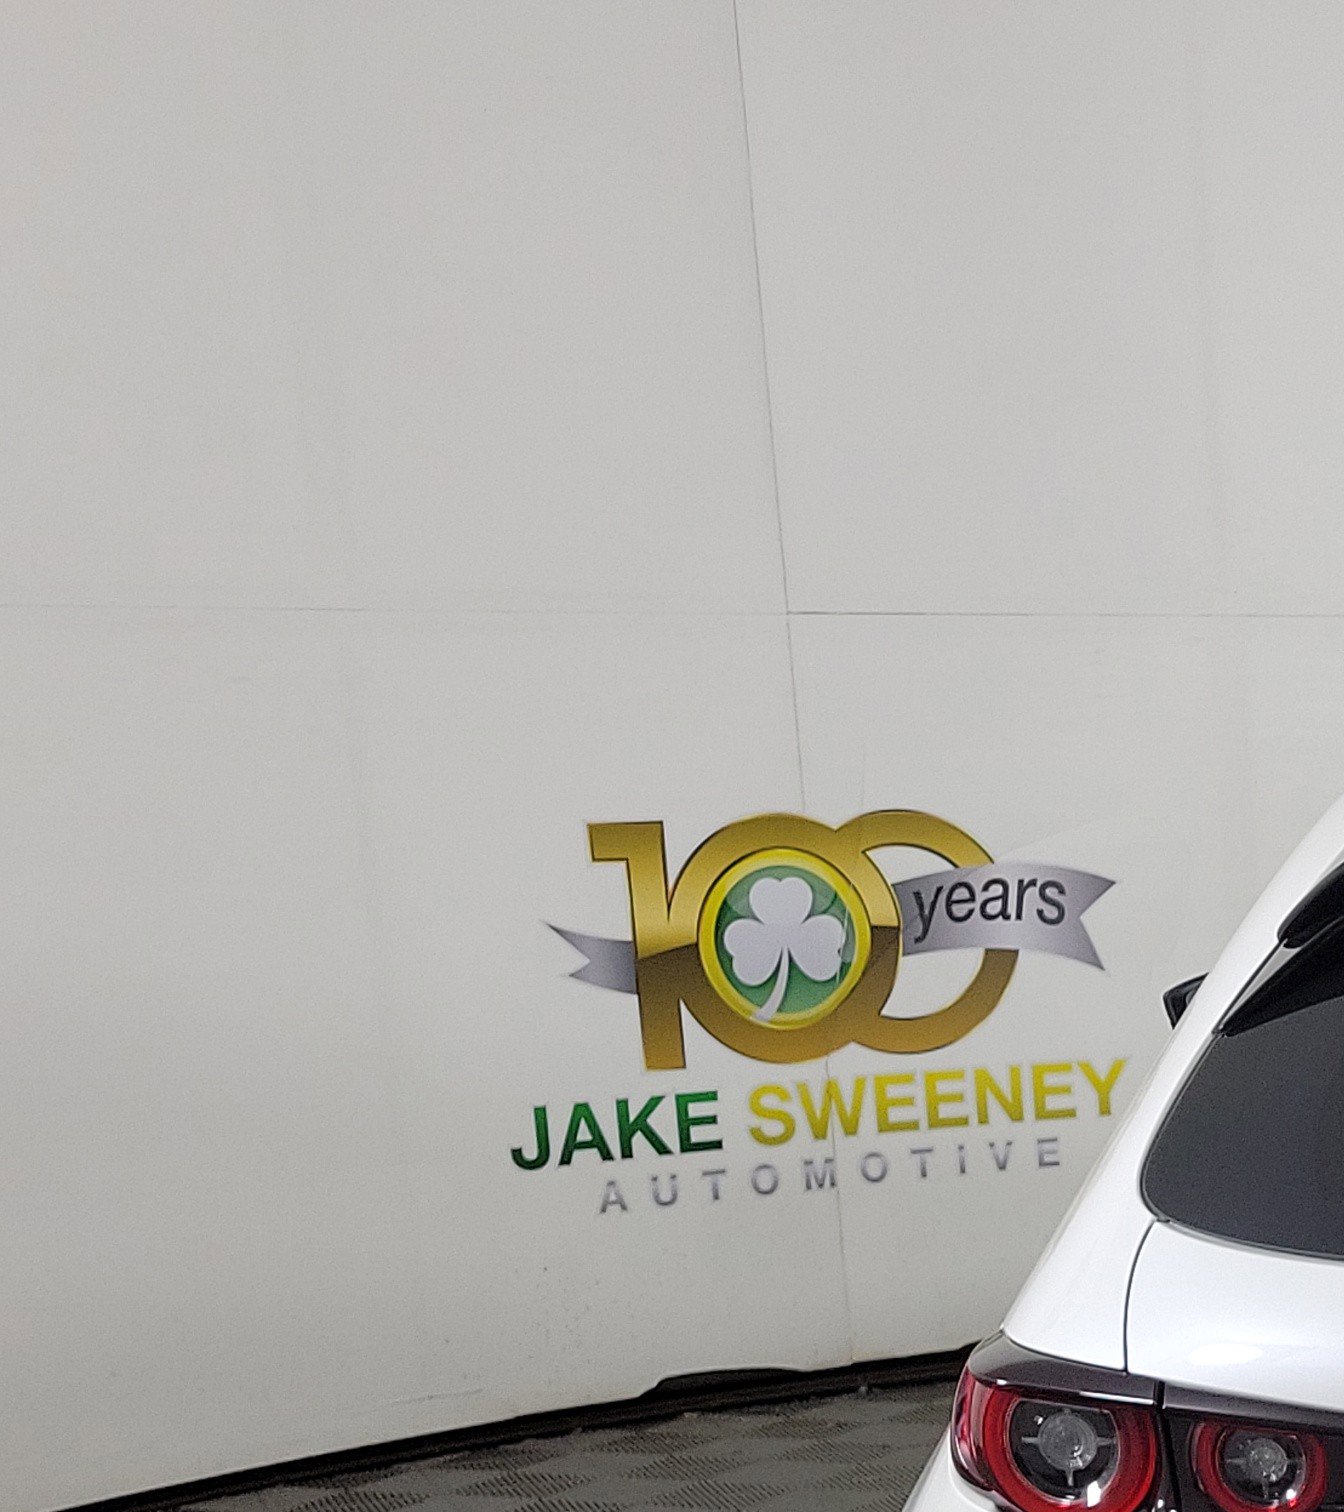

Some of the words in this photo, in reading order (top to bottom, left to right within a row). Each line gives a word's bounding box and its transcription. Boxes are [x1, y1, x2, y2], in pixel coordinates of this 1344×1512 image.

[587, 809, 1019, 1070] 100
[912, 875, 1067, 943] years
[511, 1090, 723, 1171] JAKE
[748, 1059, 1127, 1146] SWEENEY
[599, 1137, 1060, 1213] AUTOMOTIVE
